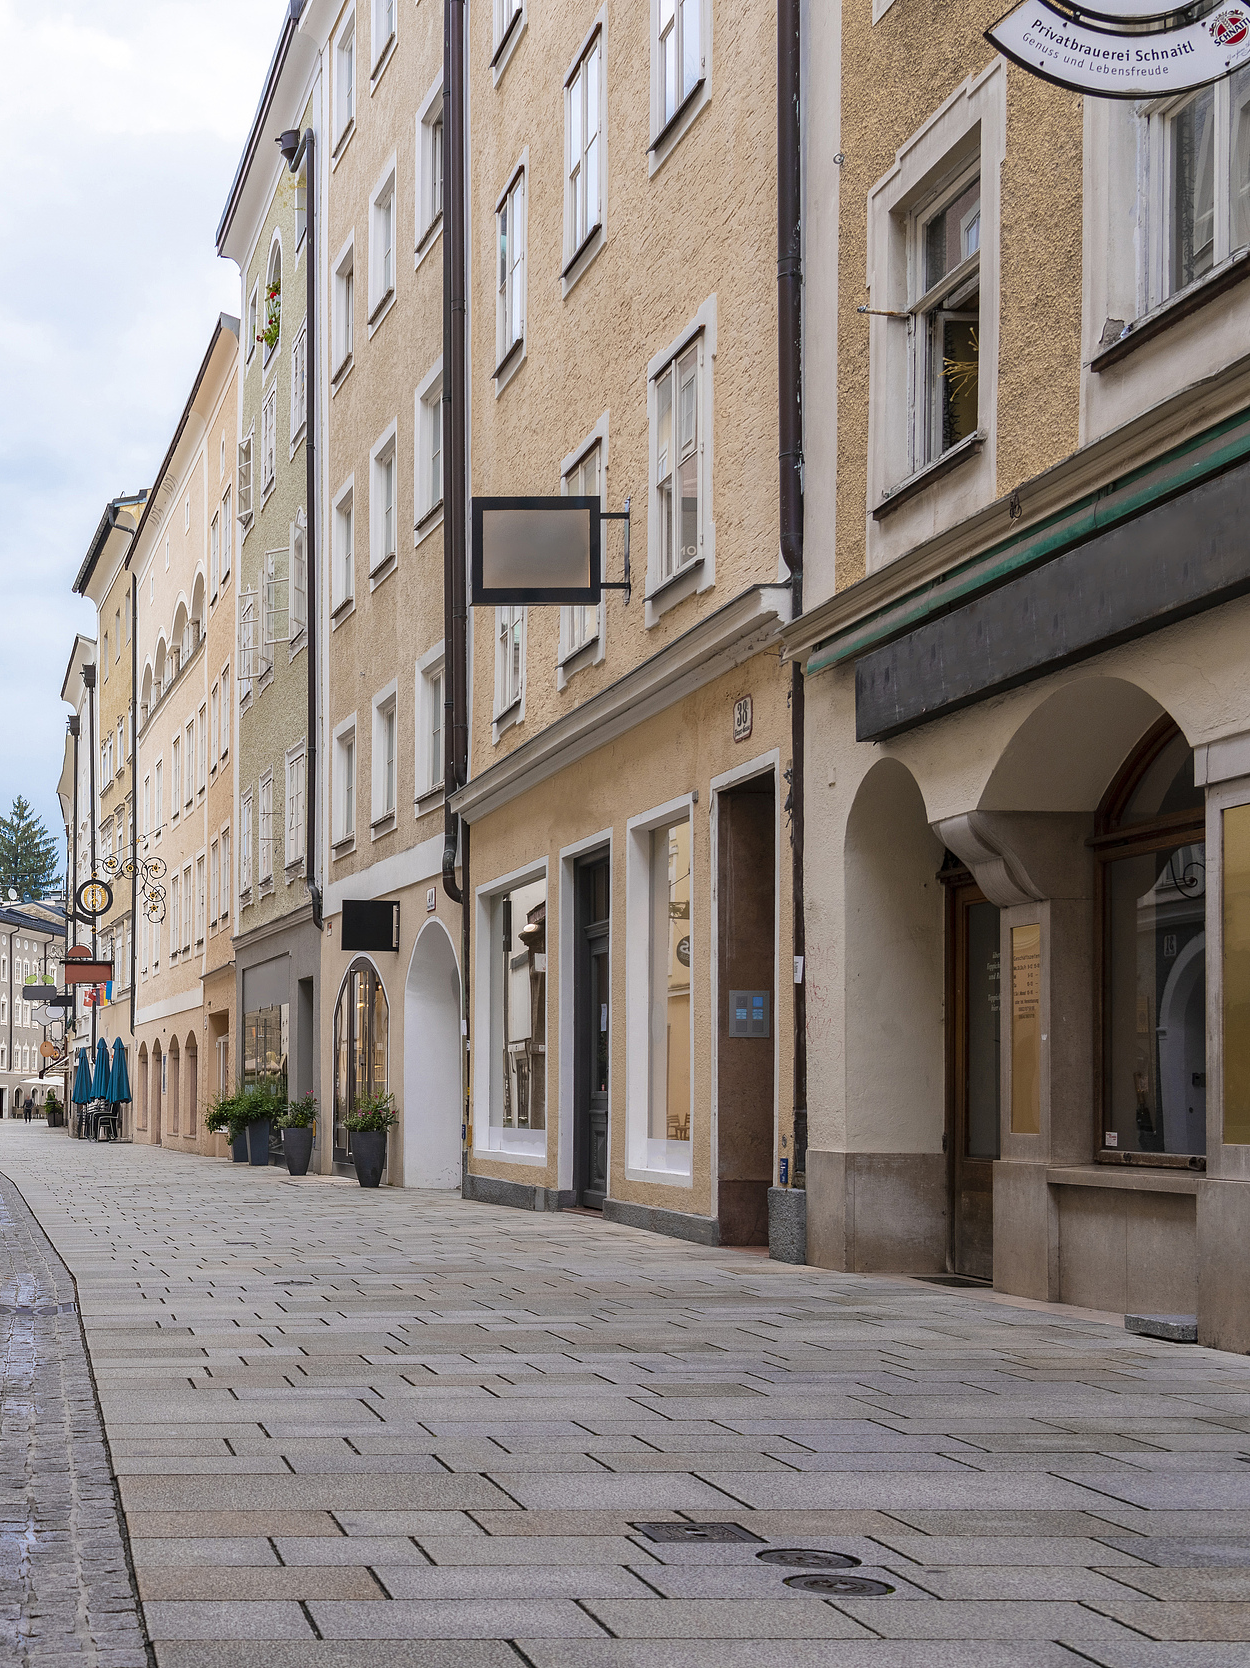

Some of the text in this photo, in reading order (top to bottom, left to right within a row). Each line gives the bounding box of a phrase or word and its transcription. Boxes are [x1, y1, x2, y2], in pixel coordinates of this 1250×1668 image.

[1022, 32, 1169, 77] Genuss und Lebensfreude
[1031, 19, 1130, 61] Privatbrauerei
[1135, 40, 1195, 62] Schnaitl
[736, 699, 748, 727] 38
